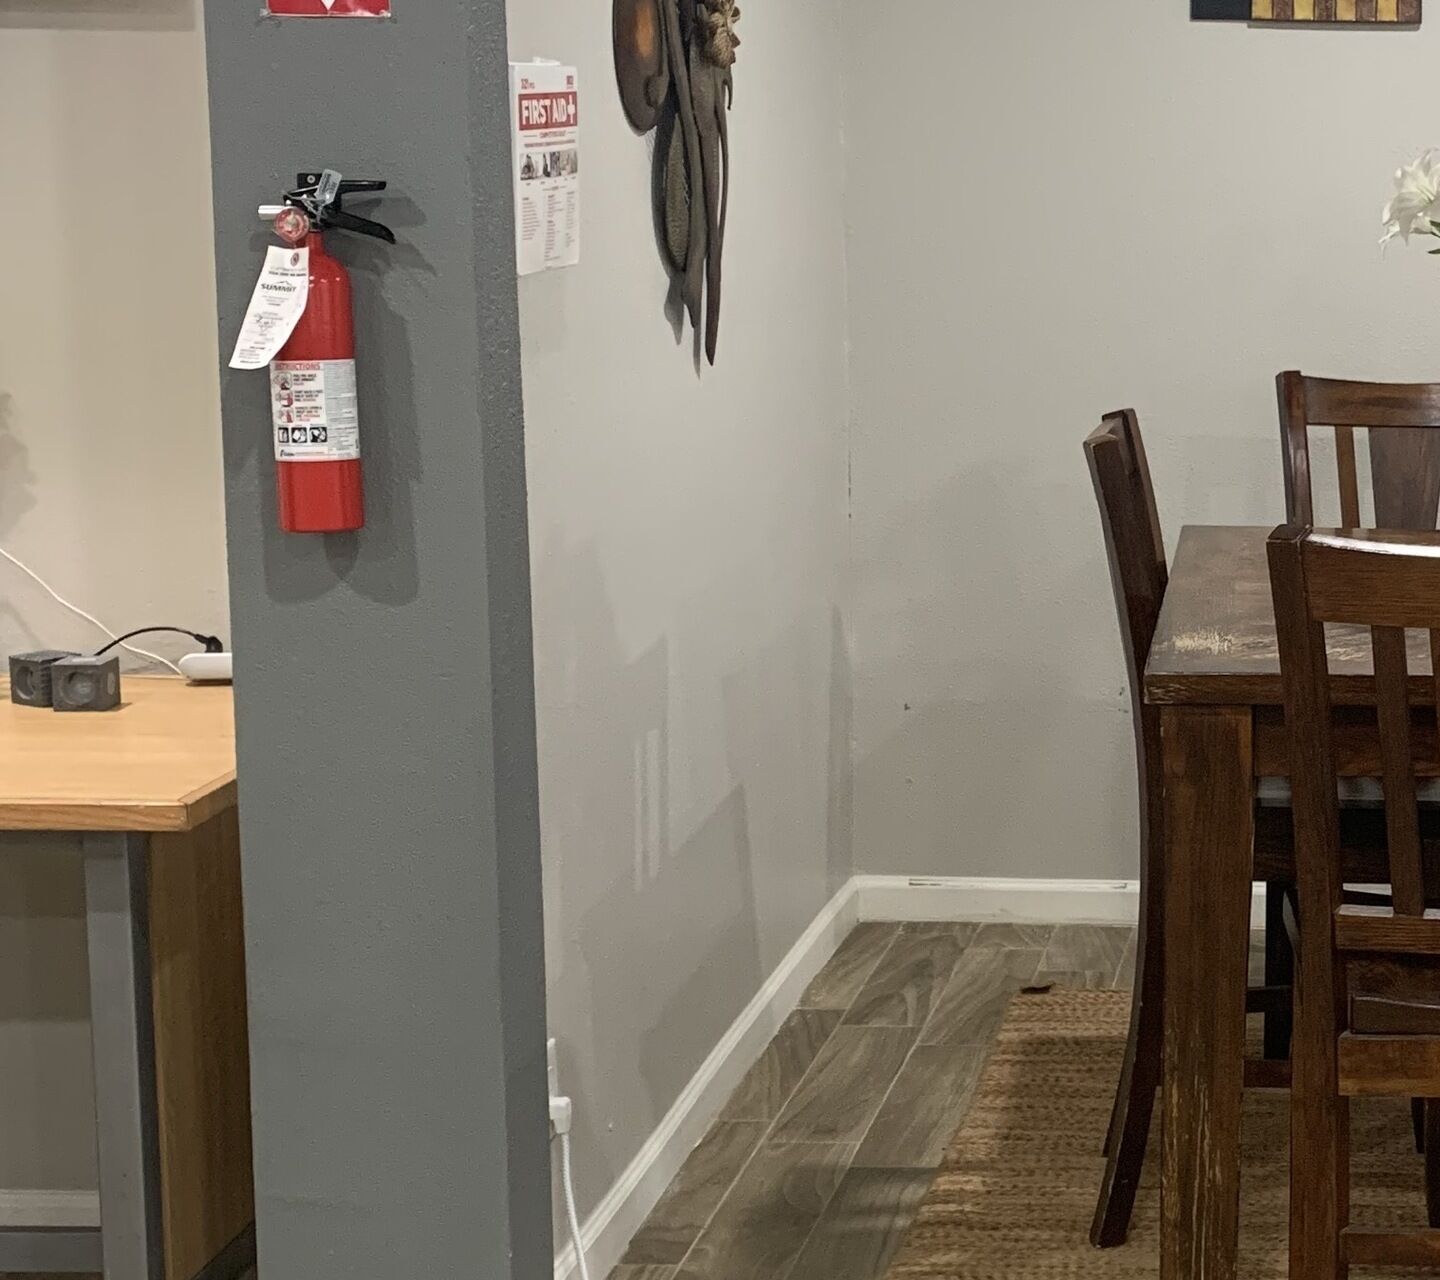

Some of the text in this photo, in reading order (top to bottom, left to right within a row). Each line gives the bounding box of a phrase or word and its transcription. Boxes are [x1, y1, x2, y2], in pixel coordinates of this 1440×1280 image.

[521, 97, 567, 125] FIRST AID
[260, 283, 297, 292] SUMMIT
